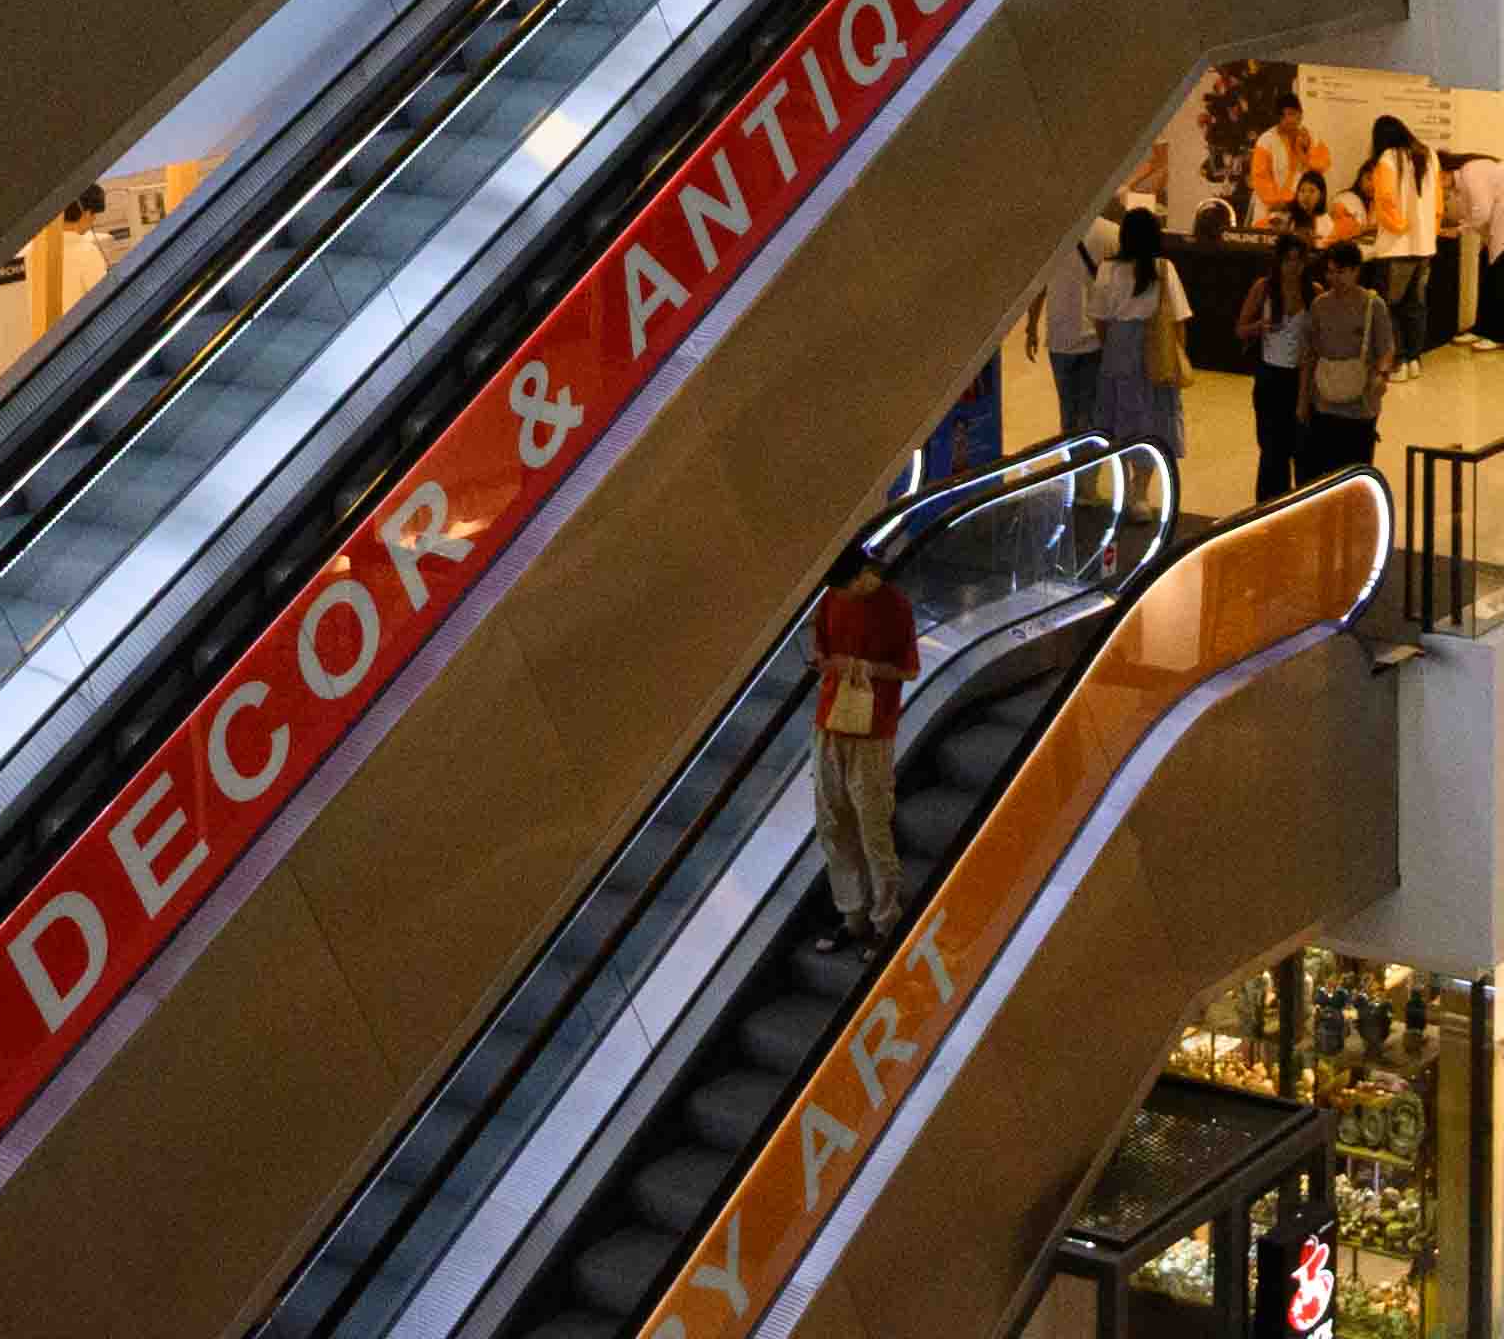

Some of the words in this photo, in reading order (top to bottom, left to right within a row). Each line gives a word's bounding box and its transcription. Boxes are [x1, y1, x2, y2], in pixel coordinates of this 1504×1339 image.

[6, 480, 474, 1034] DECOR
[510, 359, 584, 468] &
[799, 908, 971, 1212] ART
